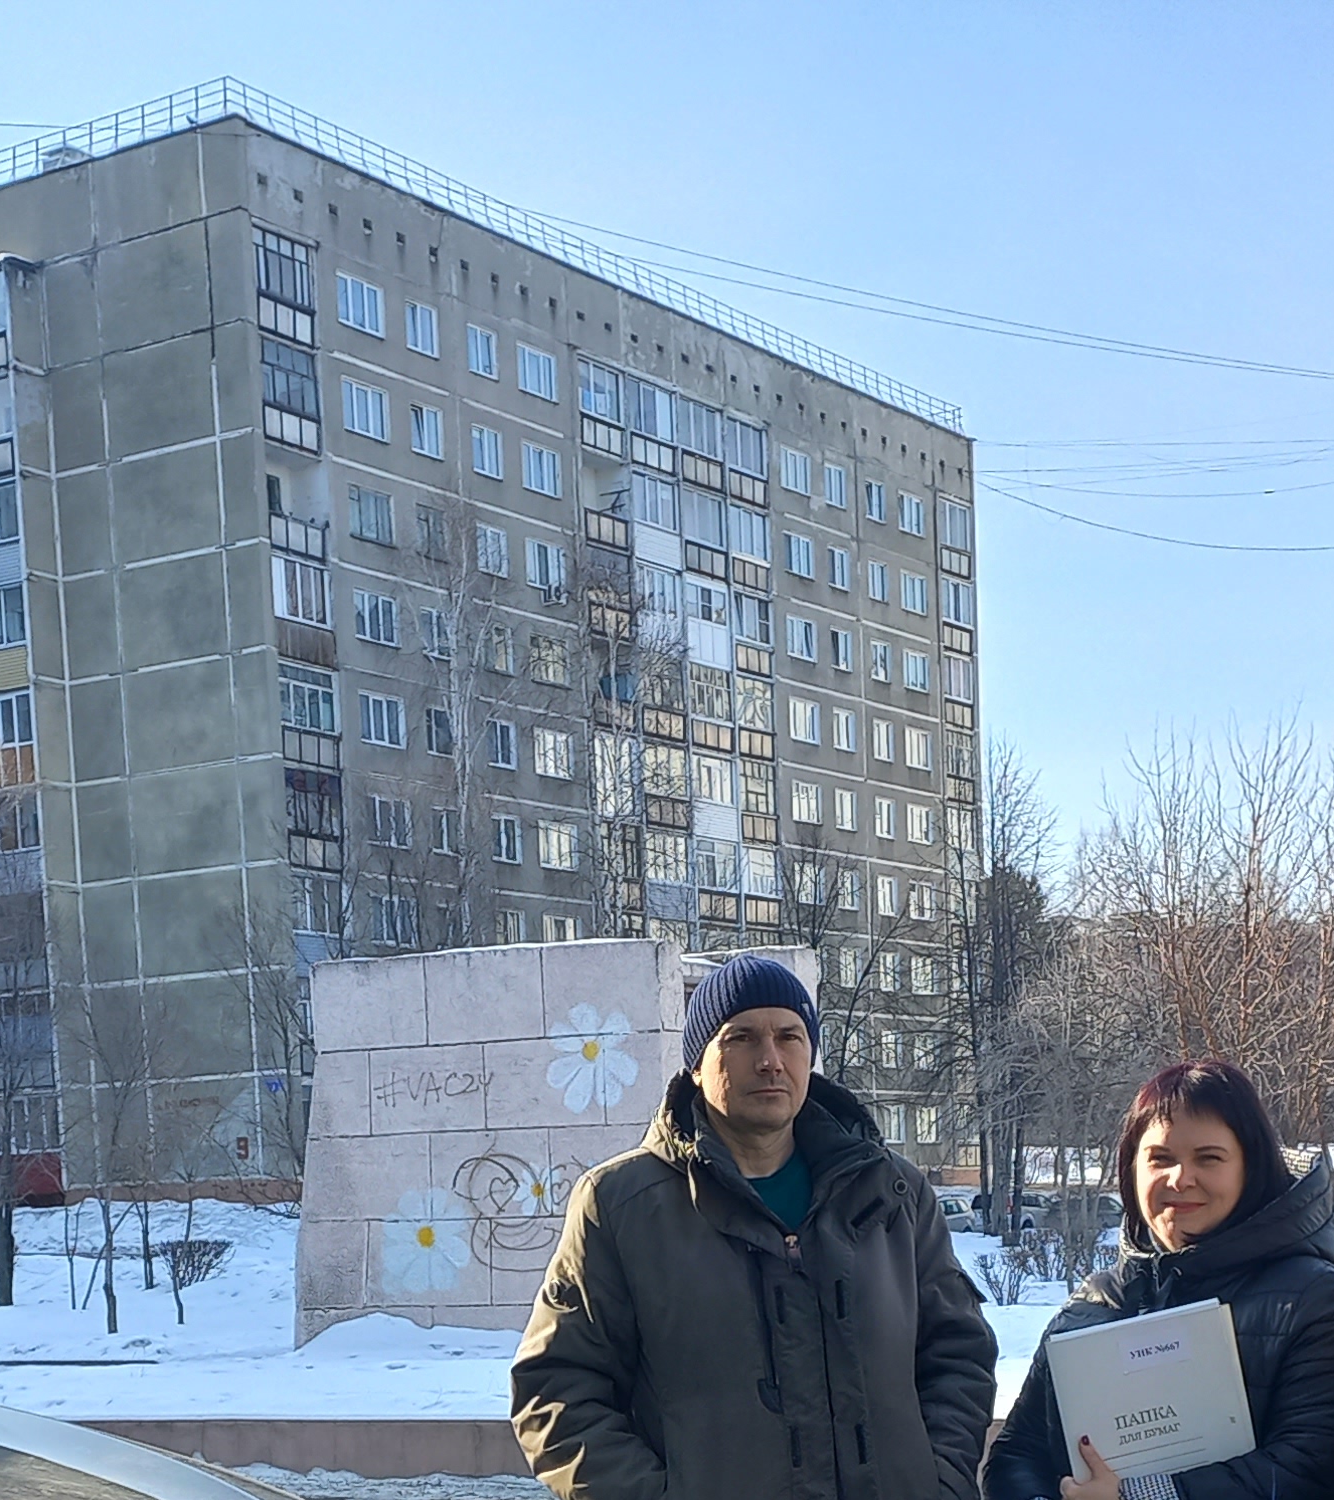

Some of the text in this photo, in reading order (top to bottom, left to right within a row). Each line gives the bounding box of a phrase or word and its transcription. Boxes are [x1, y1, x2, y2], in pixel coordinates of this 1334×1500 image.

[1129, 1346, 1153, 1360] УИК
[1114, 1405, 1178, 1431] ПАПКА
[1119, 1422, 1181, 1446] ДЛЯ БУМАГ
